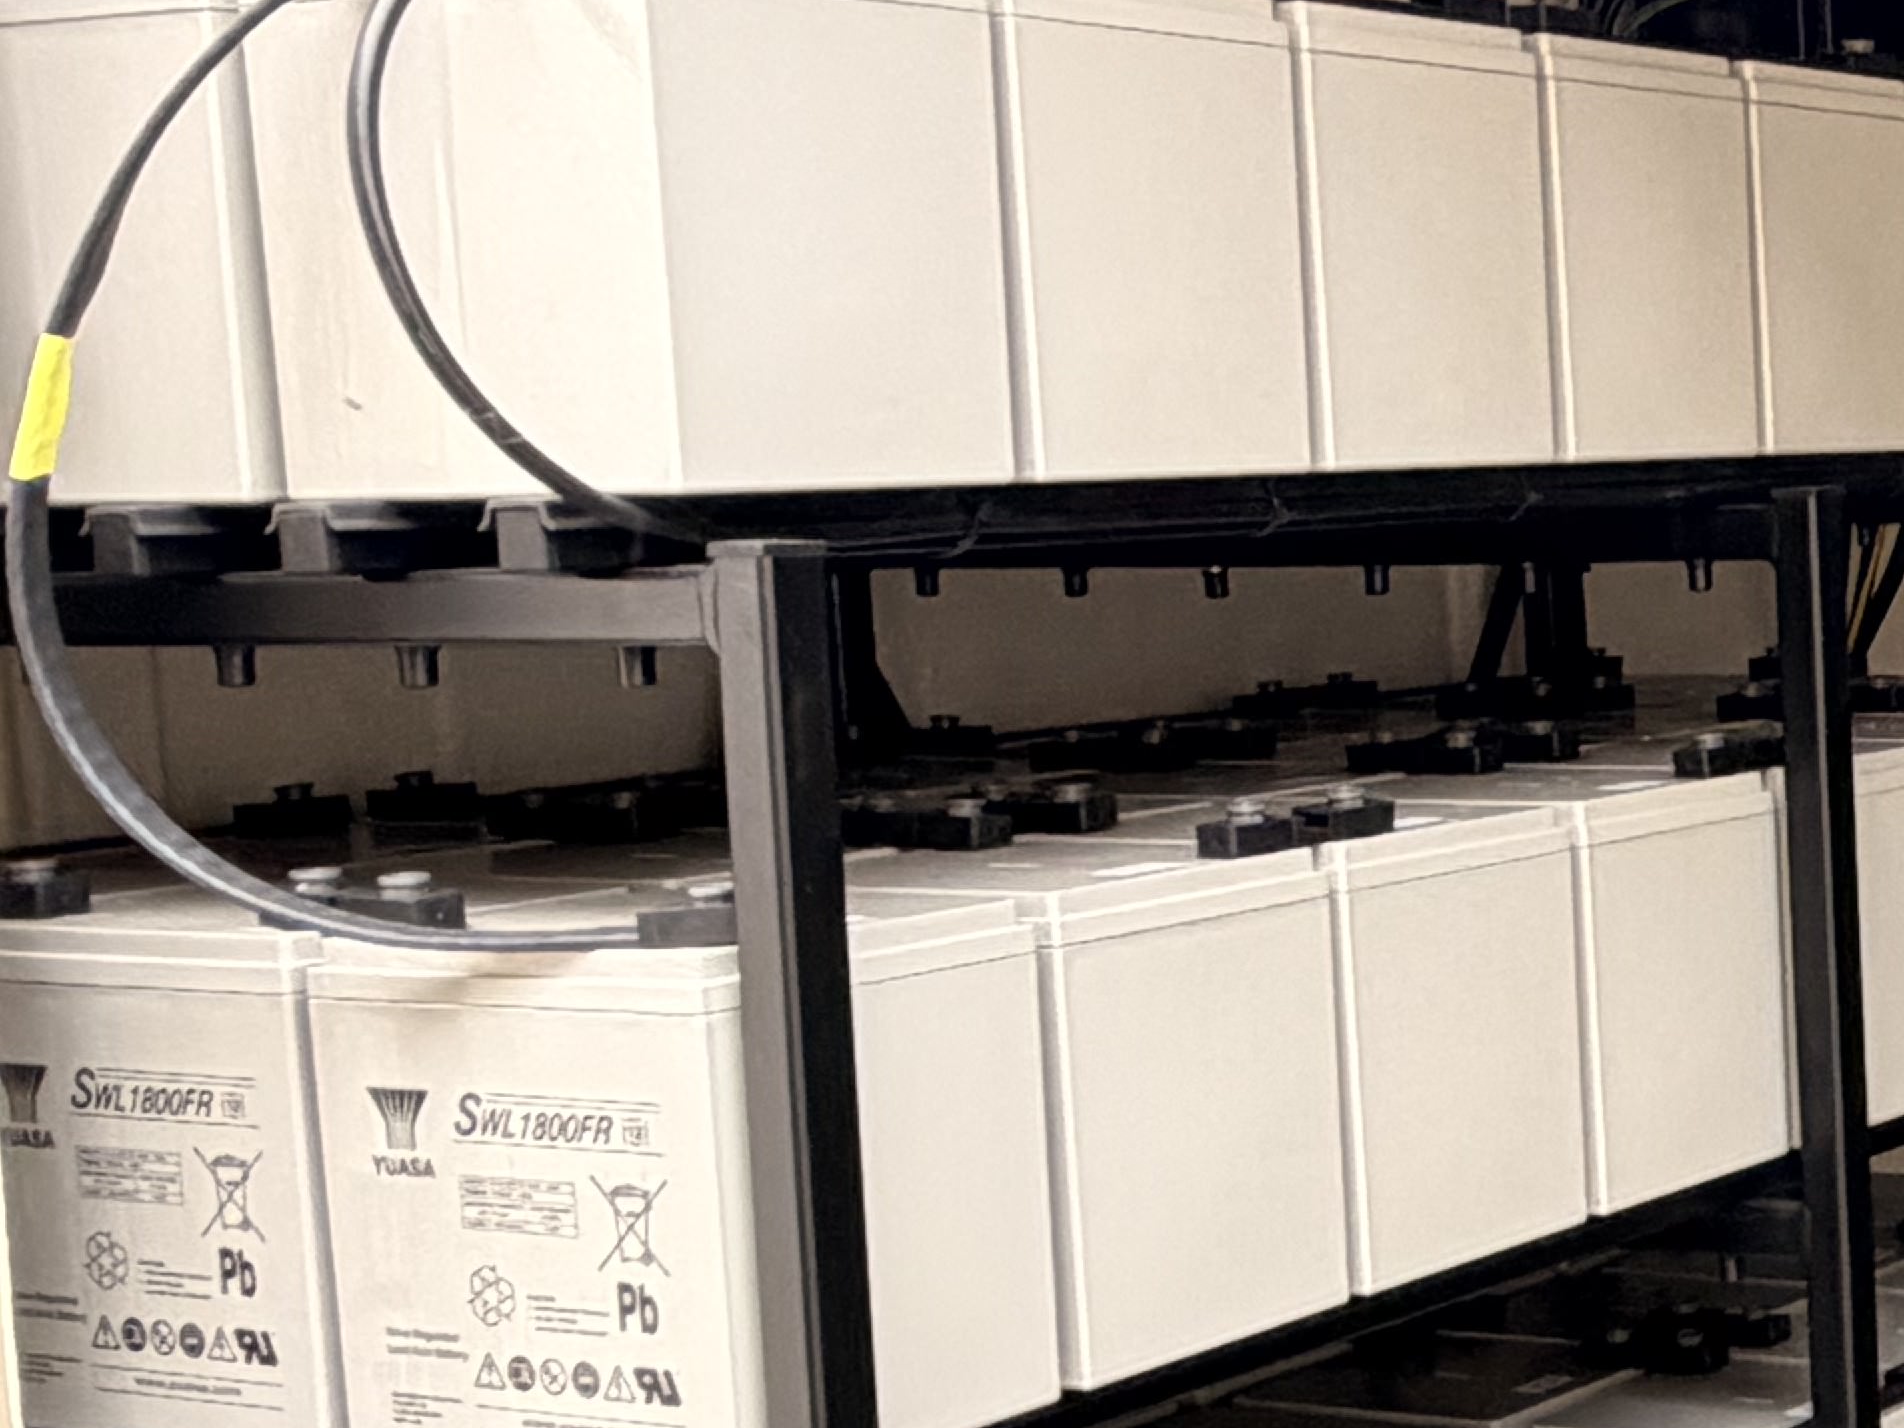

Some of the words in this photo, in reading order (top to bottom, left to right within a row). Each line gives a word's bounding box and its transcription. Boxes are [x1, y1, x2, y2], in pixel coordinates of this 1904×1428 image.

[71, 1067, 213, 1117] SWL1800FR
[454, 1092, 614, 1144] SWL1800FR
[371, 1154, 436, 1178] YUASA
[218, 1247, 257, 1298] Pb
[617, 1282, 660, 1335] Pb
